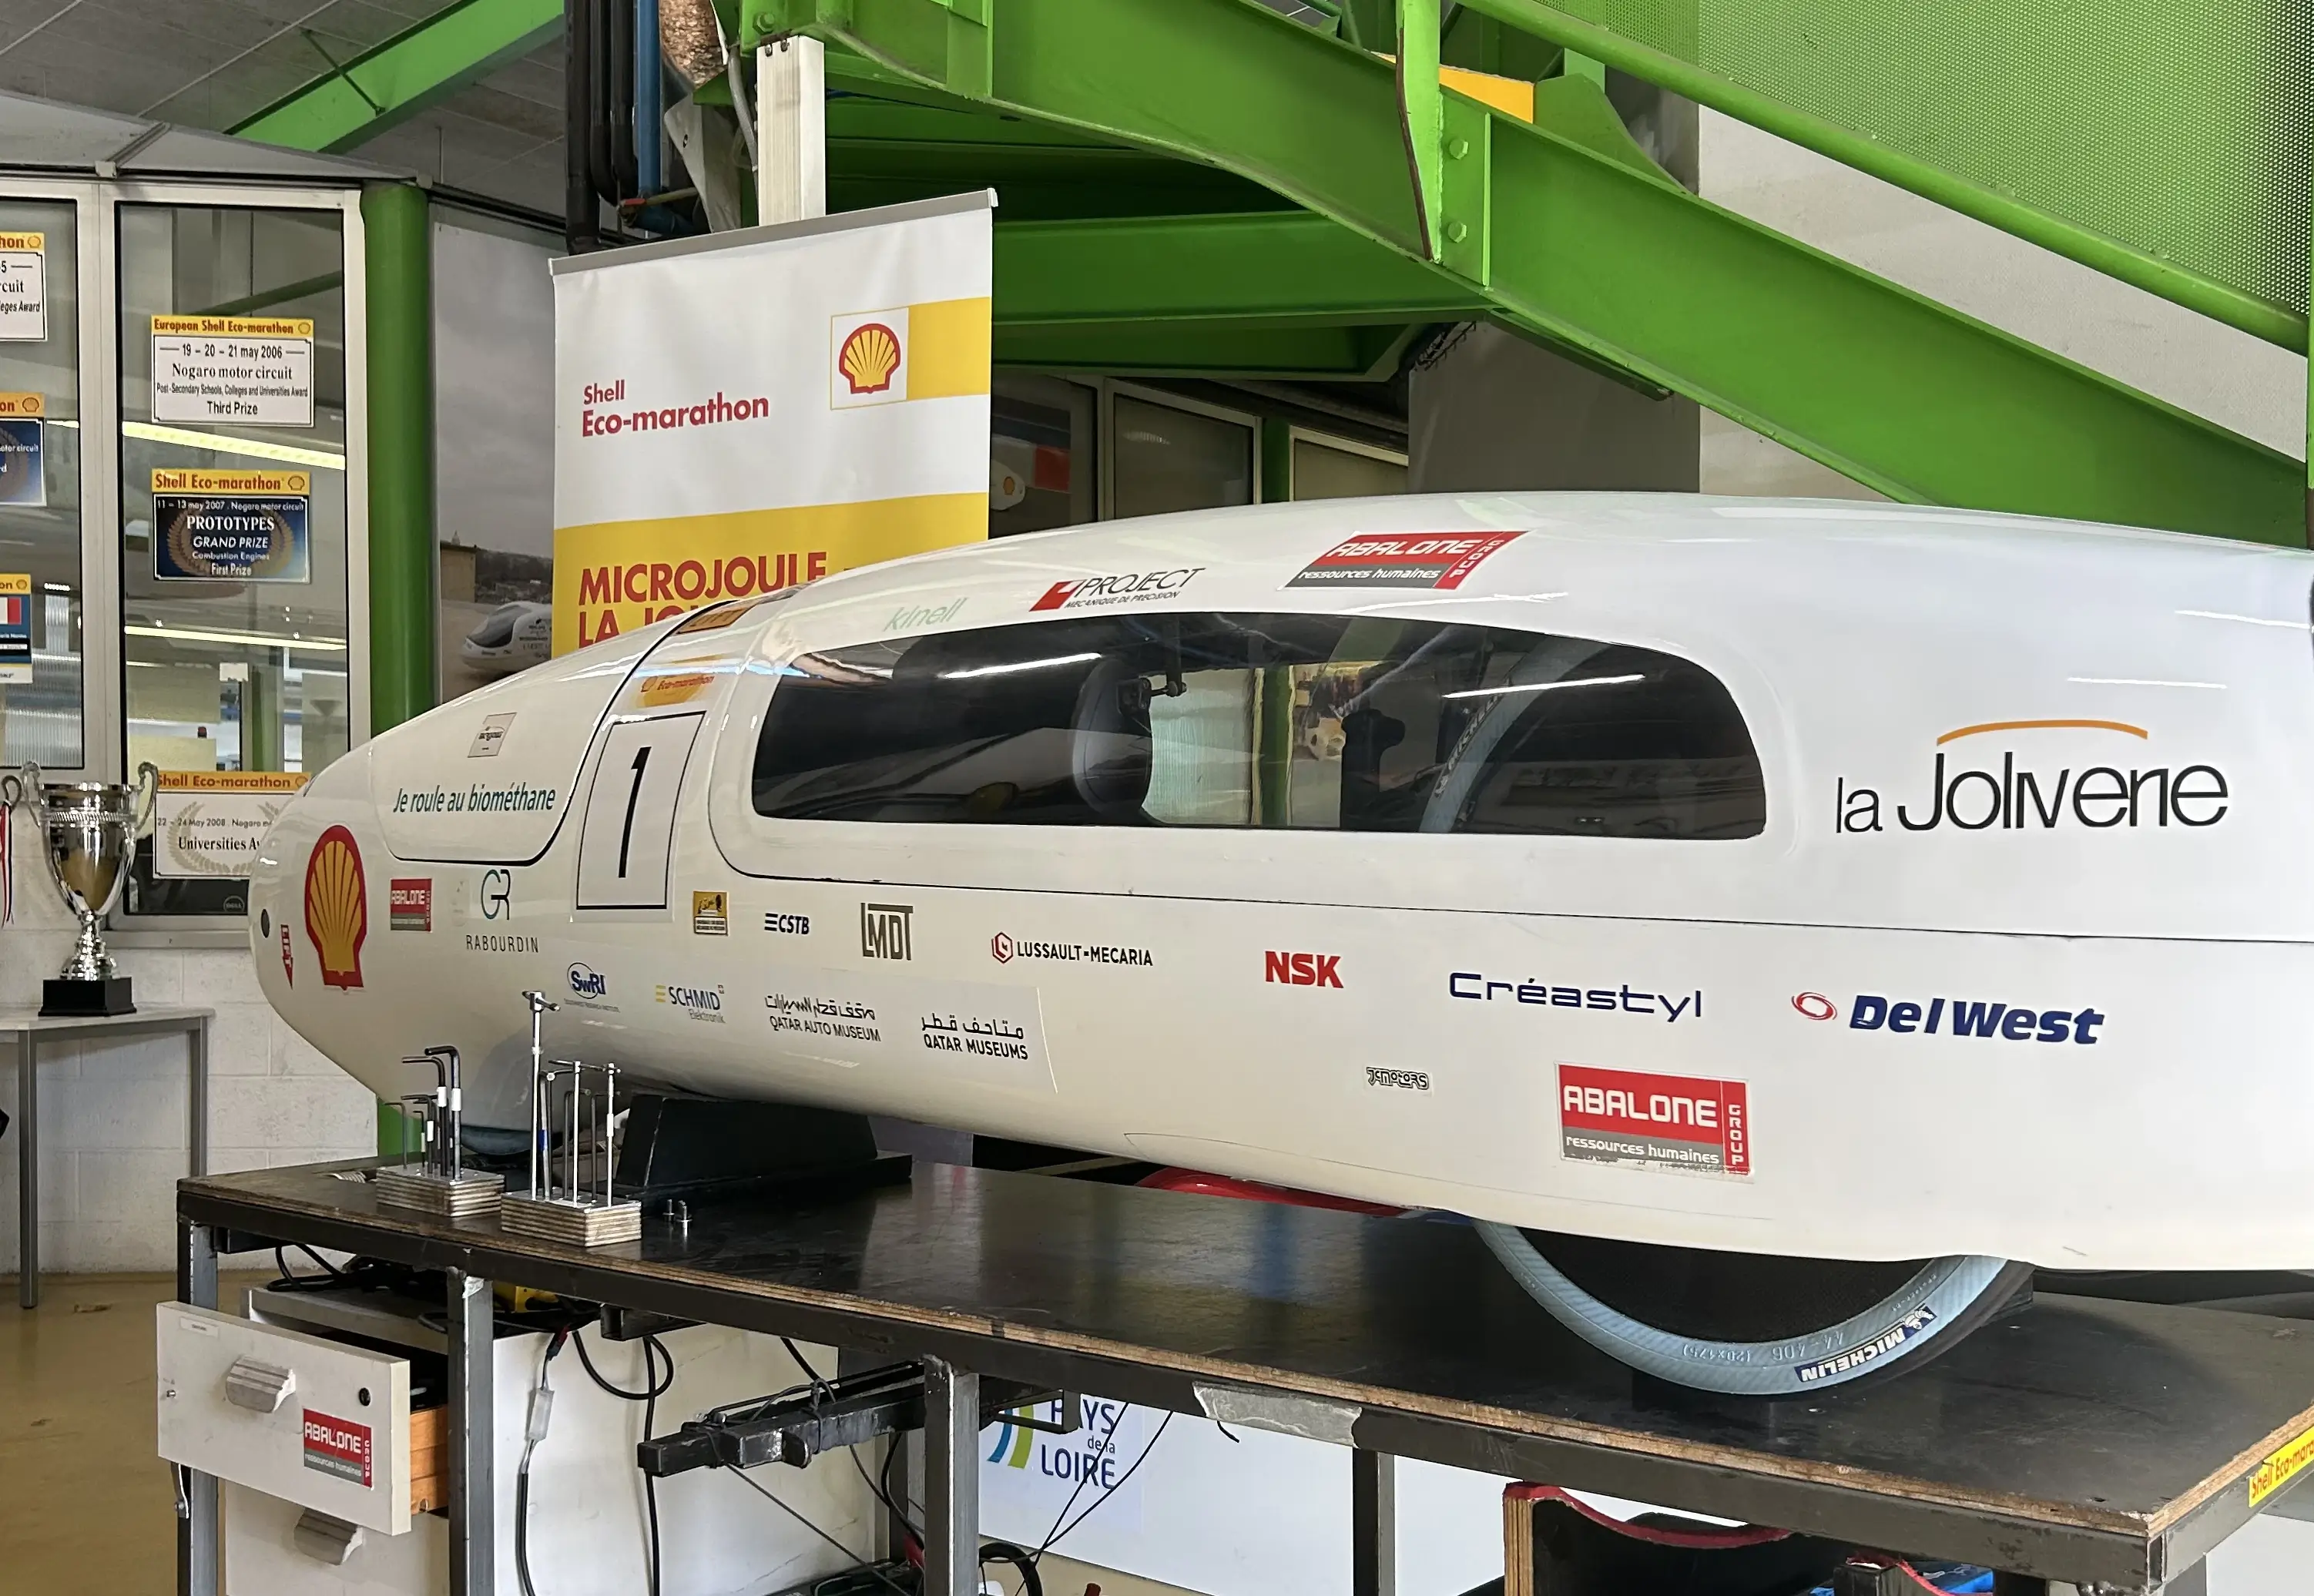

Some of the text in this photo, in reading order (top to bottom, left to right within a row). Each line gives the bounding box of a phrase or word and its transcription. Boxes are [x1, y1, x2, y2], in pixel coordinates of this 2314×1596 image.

[154, 319, 293, 334] European Shell Eco-marathon
[183, 344, 191, 357] 19
[205, 344, 216, 357] 20
[229, 345, 237, 358] 21
[240, 348, 259, 361] may
[261, 345, 282, 359] 2006
[173, 363, 293, 381] Nogaro motor circuit
[291, 387, 308, 397] Award
[583, 380, 625, 404] Shell
[207, 401, 258, 415] Third Prize
[582, 392, 769, 438] Eco-marathon
[156, 474, 281, 490] Shell Eco-marathon
[157, 499, 166, 508] 11
[188, 501, 204, 511] may
[206, 501, 225, 510] 2007
[231, 501, 260, 513] Nogaro
[261, 502, 281, 511] motor
[283, 503, 304, 511] circuit
[186, 515, 275, 531] PROTOTYPES
[193, 535, 268, 548] GRAND PRIZE
[1326, 539, 1483, 558] ABALONE
[192, 551, 270, 562] Combustion Engines
[1449, 539, 1504, 578] GROUP
[211, 562, 252, 576] First Prize
[1298, 568, 1441, 579] ressources humaines
[1074, 568, 1206, 598] PROJECT
[578, 609, 619, 649] LA
[193, 775, 290, 788] Eco-marathon
[1836, 751, 2228, 833] la Joliverie
[393, 782, 556, 813] Je roule au biométhane
[157, 817, 166, 826] 22
[177, 818, 186, 826] 24
[188, 818, 204, 828] May
[206, 818, 226, 826] 2008
[232, 819, 262, 829] Nogaro
[619, 746, 652, 878] 1
[178, 837, 246, 851] Universities
[779, 914, 810, 935] CSTB
[860, 902, 914, 961] LMDT
[466, 934, 539, 953] RABOURDIN
[1265, 950, 1343, 989] NSK
[571, 971, 606, 995] SwRI
[669, 986, 720, 1011] SCHMID
[1450, 971, 1701, 1023] Créastyl
[770, 1015, 881, 1041] QATAR AUTO MUSEUM
[921, 1012, 1024, 1039] متاحف قطر
[924, 1034, 1028, 1060] QATAR MUSEUMS
[1564, 1085, 1718, 1128] ABALONE
[1728, 1104, 1744, 1165] GROUP
[1566, 1136, 1719, 1165] ressources humaines
[1801, 1326, 1906, 1383] MICHELIN
[304, 1421, 361, 1454] ABALONE
[1041, 1444, 1115, 1490] LOIRE
